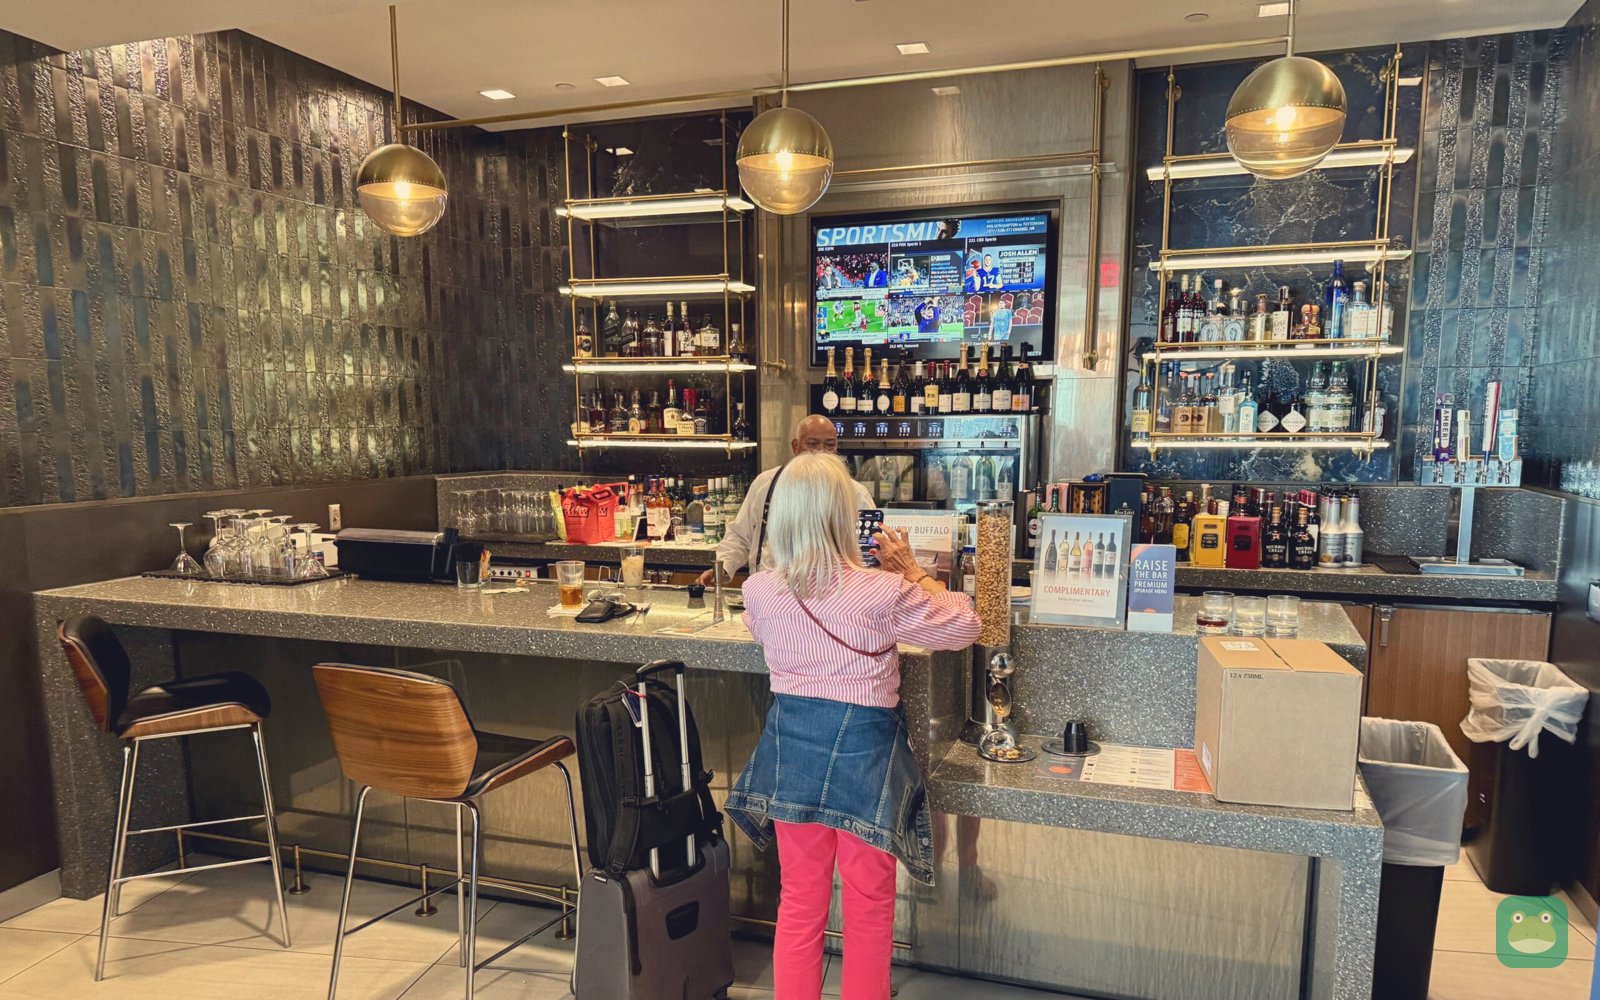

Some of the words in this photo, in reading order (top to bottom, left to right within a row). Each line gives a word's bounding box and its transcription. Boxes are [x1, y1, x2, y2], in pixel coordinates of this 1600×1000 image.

[983, 275, 995, 287] 17
[914, 526, 950, 535] BUFFALO
[1134, 559, 1169, 571] RAISE
[1135, 570, 1150, 579] THE
[1152, 571, 1168, 580] BAR
[1134, 580, 1168, 589] PREMIUM
[1043, 585, 1111, 597] COMPLIMENTARY
